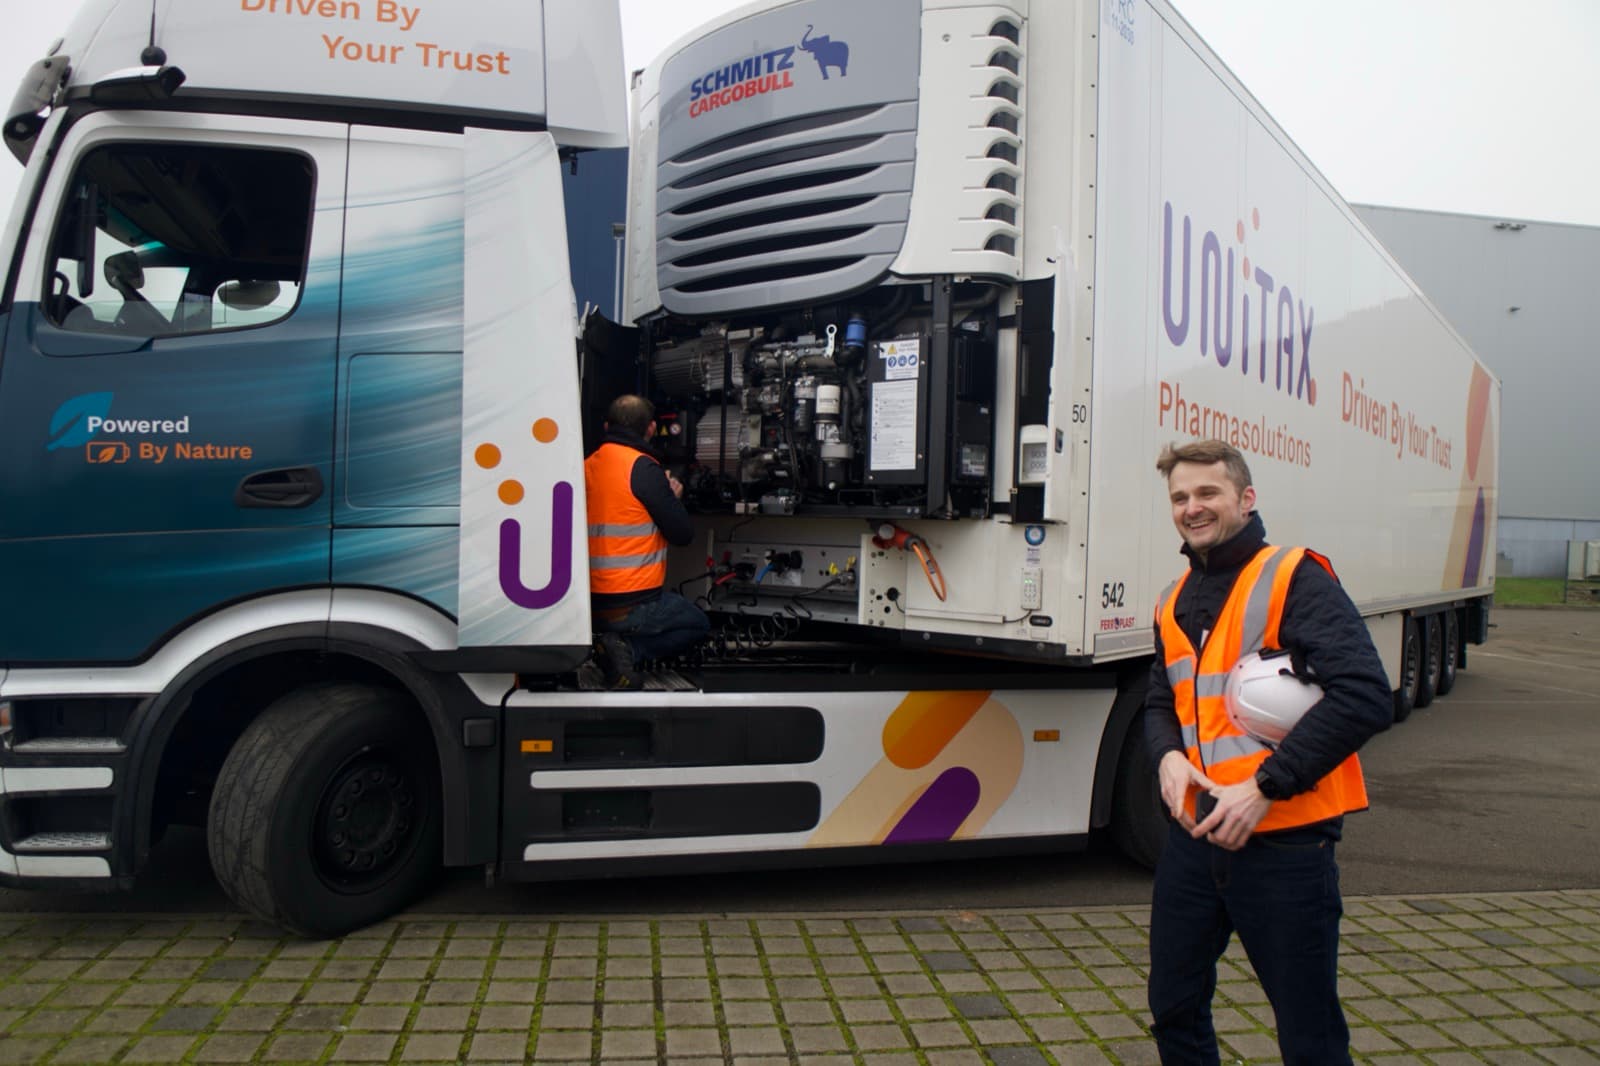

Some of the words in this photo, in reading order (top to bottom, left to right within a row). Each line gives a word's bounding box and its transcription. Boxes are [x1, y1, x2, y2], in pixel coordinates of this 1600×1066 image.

[376, 0, 420, 31] By
[321, 34, 404, 64] Your
[415, 42, 510, 75] Trust
[690, 45, 796, 101] SCHMITZ
[688, 71, 794, 119] CARGOBULL
[87, 415, 190, 433] Powered
[1072, 404, 1087, 423] 50
[1159, 381, 1311, 468] Pharmasolutions
[1342, 370, 1387, 440] Driven
[1391, 400, 1406, 460] By
[1408, 410, 1429, 459] Your
[1431, 424, 1452, 470] Trust
[139, 442, 168, 464] By
[175, 442, 253, 460] Nature
[1102, 582, 1125, 608] 542
